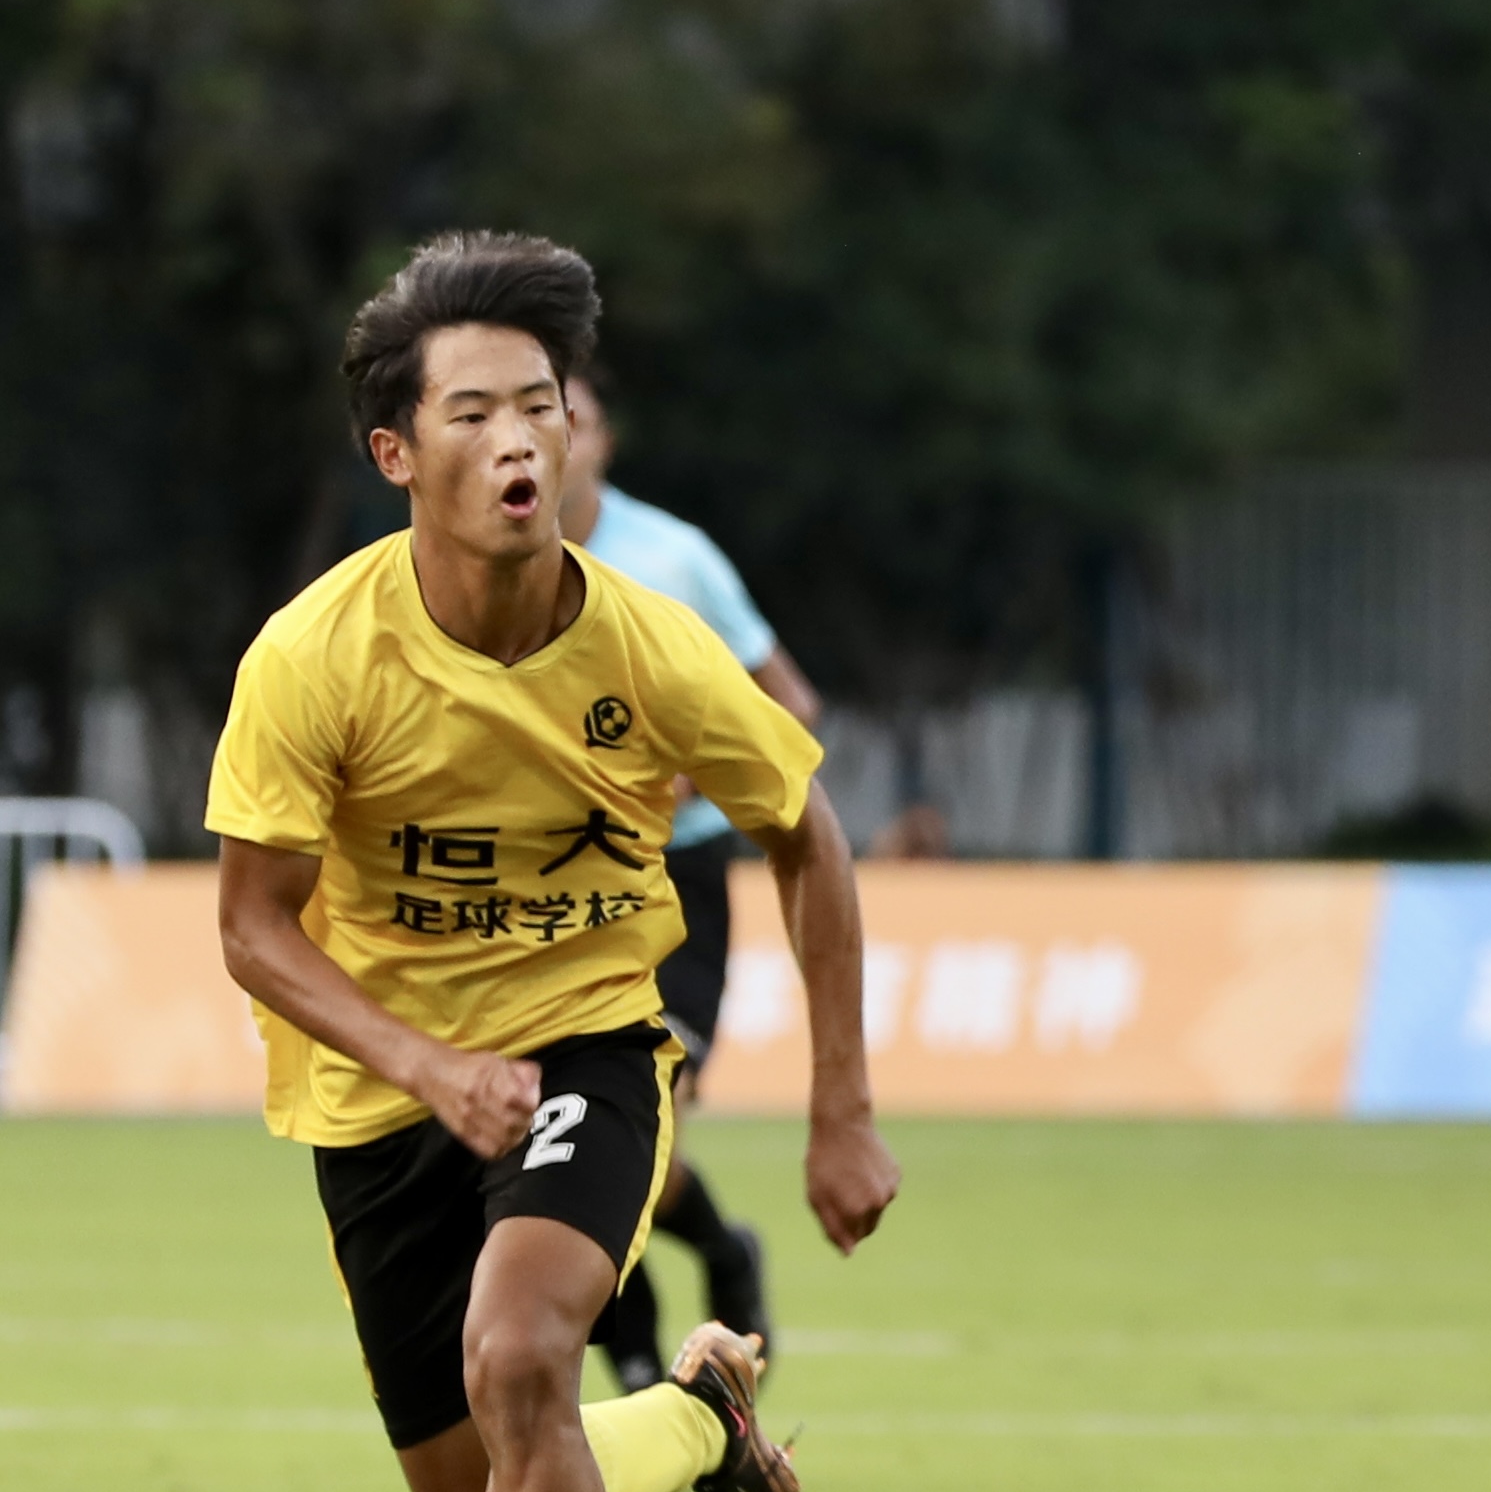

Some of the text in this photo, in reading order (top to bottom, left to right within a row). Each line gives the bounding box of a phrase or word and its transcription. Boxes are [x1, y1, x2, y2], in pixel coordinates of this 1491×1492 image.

[388, 808, 646, 886] 恒大
[388, 890, 646, 943] 足球学校
[521, 1092, 589, 1172] 2
